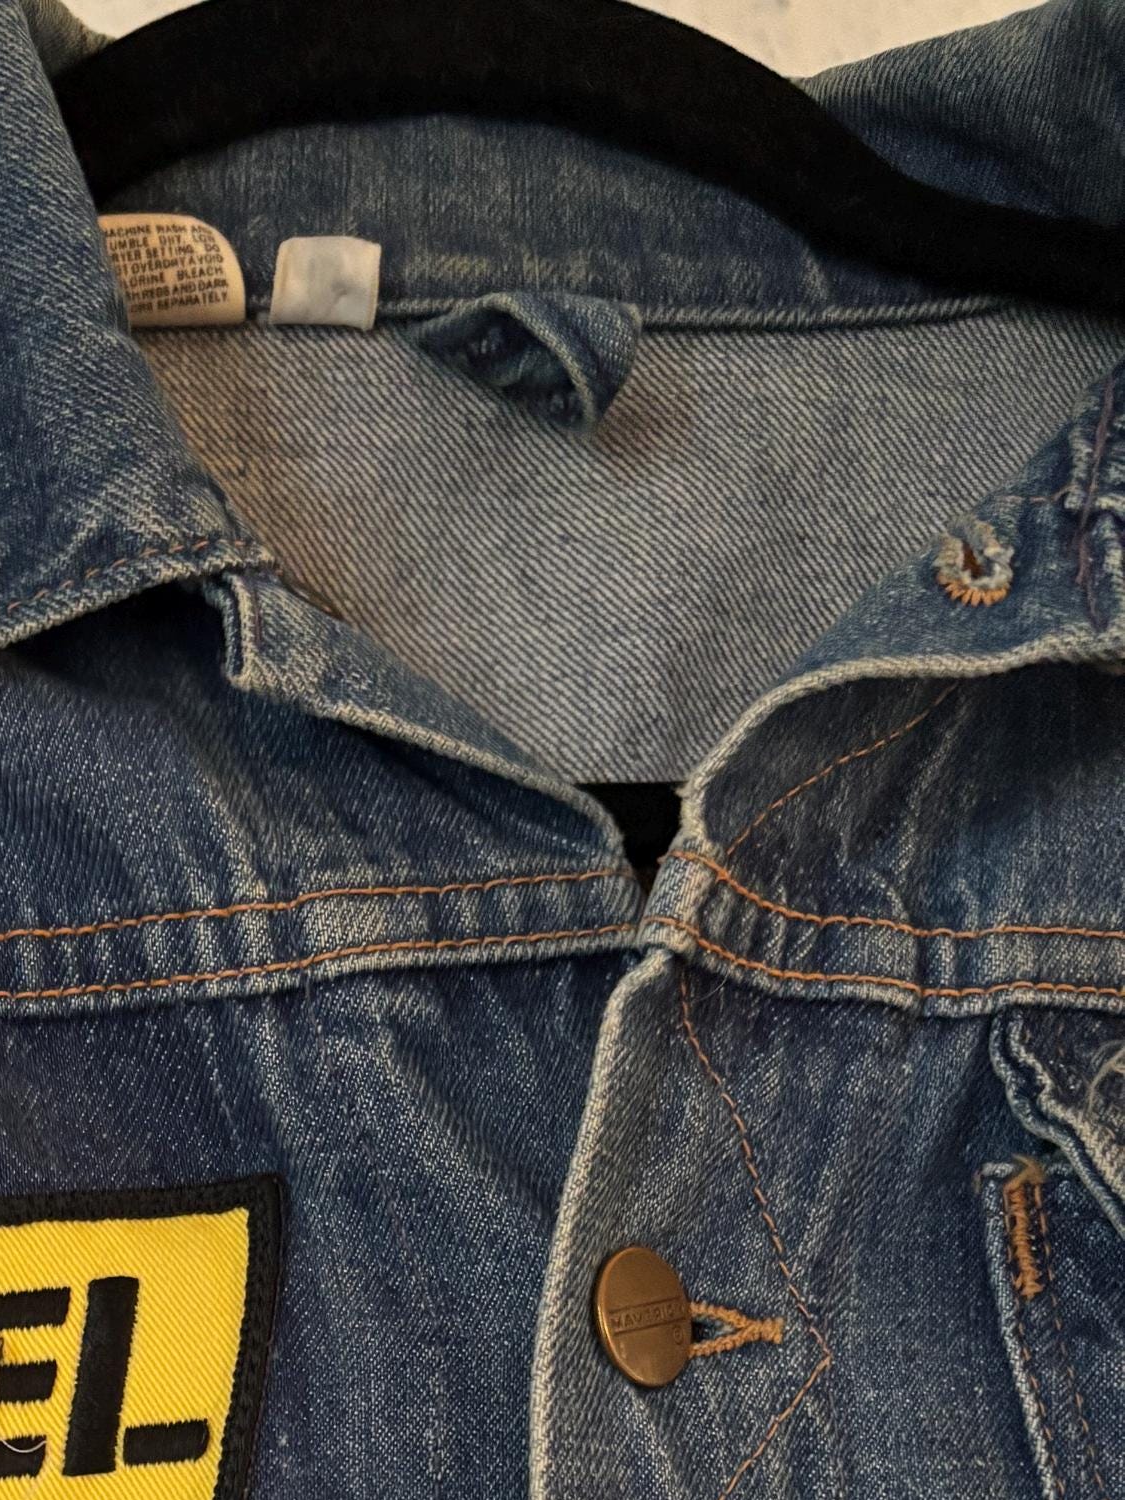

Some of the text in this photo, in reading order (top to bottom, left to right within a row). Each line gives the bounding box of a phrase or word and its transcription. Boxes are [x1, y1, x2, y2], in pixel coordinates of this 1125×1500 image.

[155, 224, 188, 234] WASH
[109, 237, 150, 252] UMBLE
[111, 250, 142, 263] RYER
[177, 265, 225, 282] BLEACH
[172, 282, 197, 297] AND
